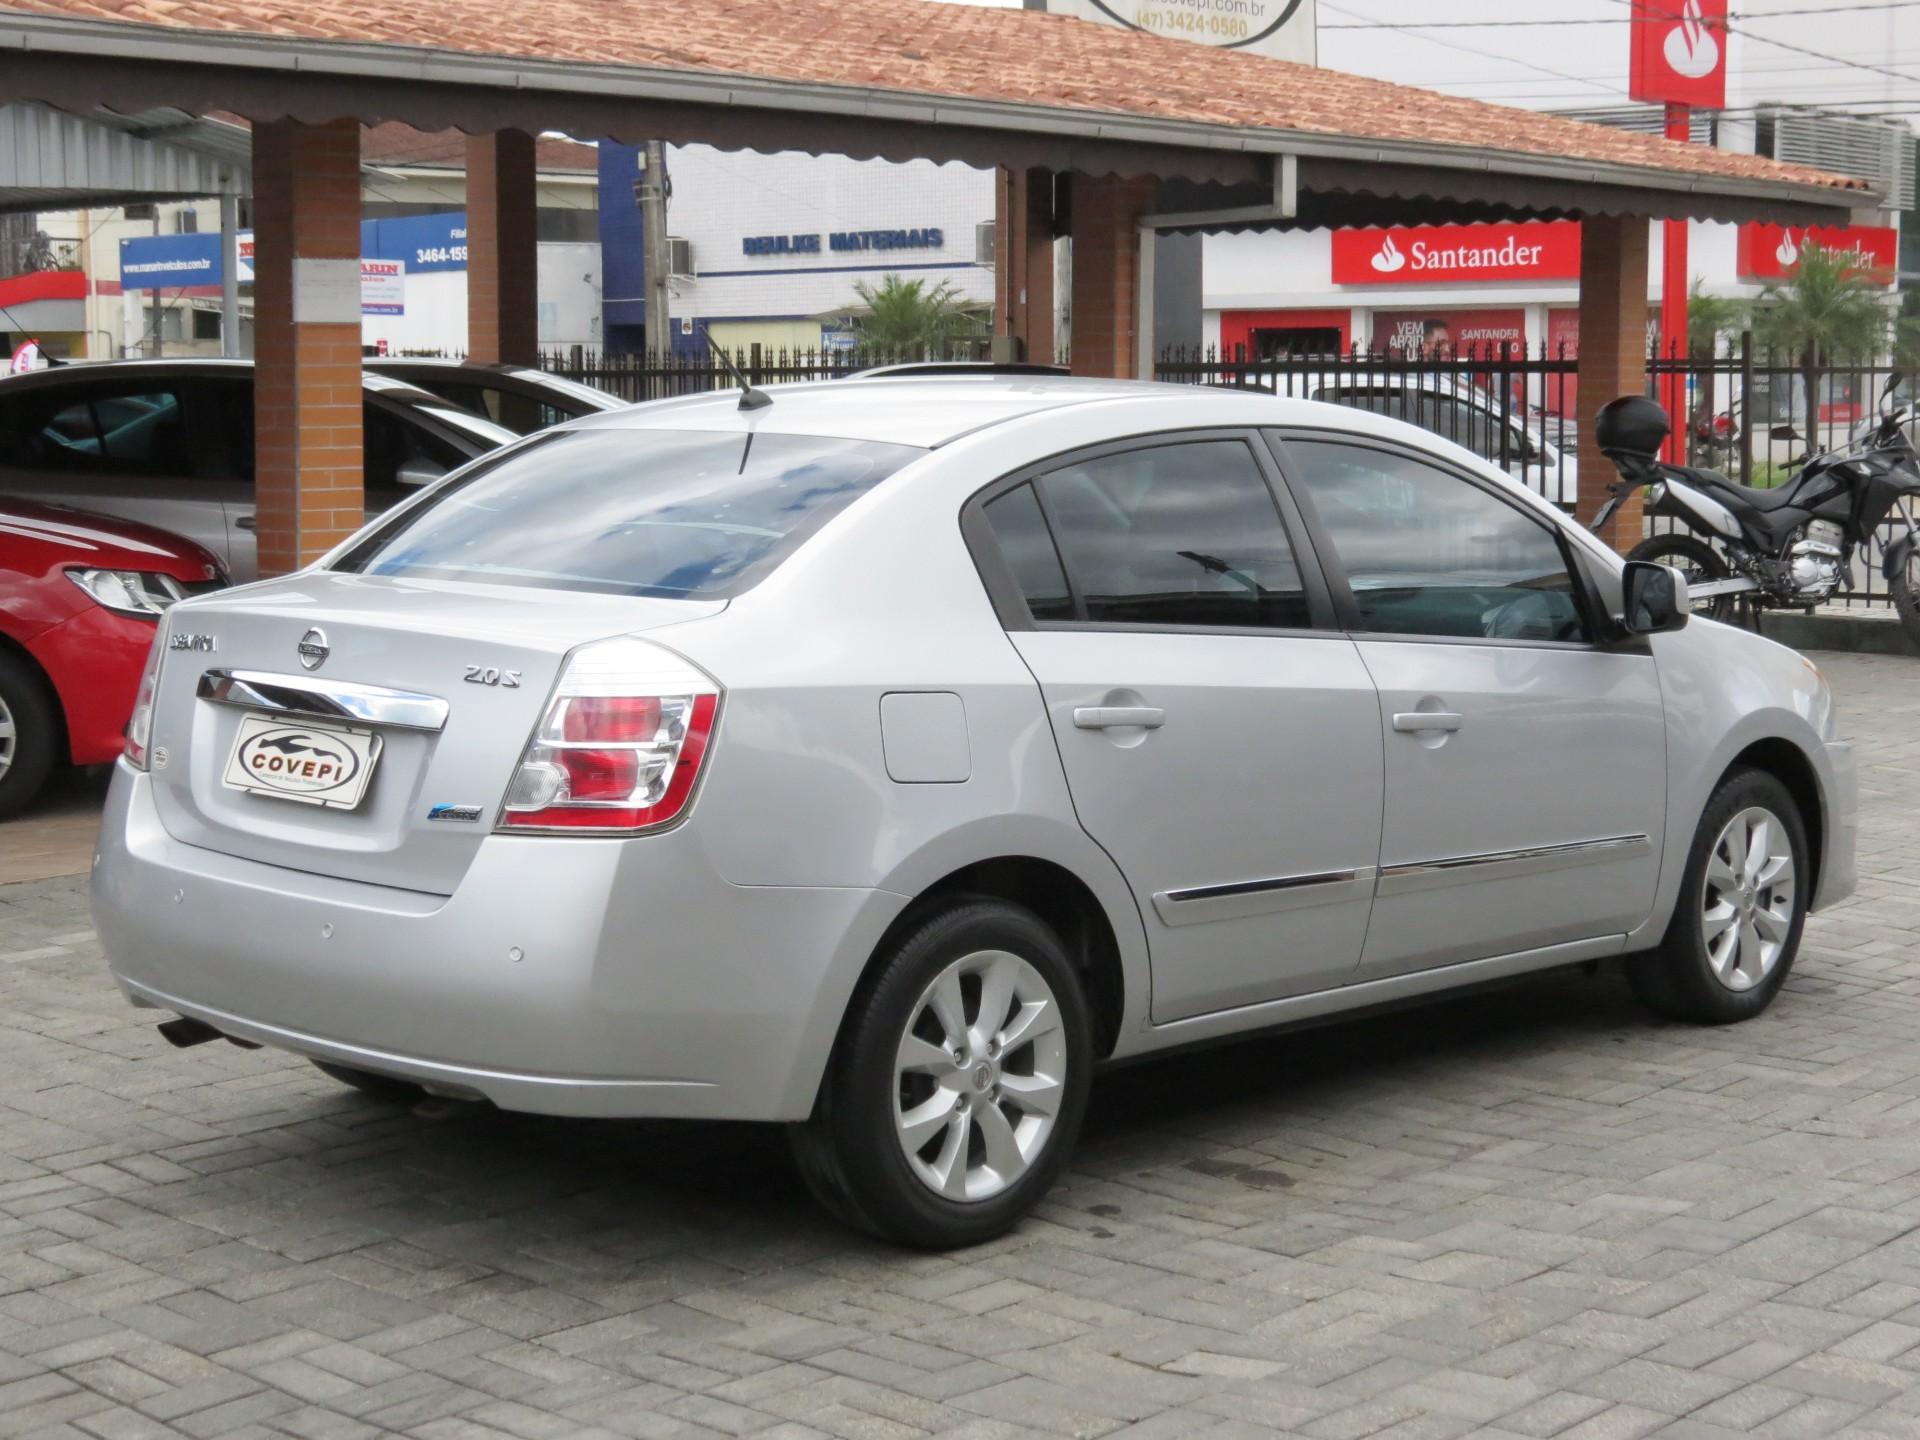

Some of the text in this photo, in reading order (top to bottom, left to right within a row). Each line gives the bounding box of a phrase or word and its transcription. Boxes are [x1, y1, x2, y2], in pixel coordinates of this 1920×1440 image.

[1136, 10, 1248, 37] (47) 3424-0580
[829, 228, 943, 252] MATERIAIS
[1411, 235, 1542, 270] Santander
[1801, 236, 1875, 269] Sntander
[1397, 321, 1424, 335] VEM
[1461, 328, 1519, 341] SANTANDER
[252, 753, 343, 782] COVEPI
